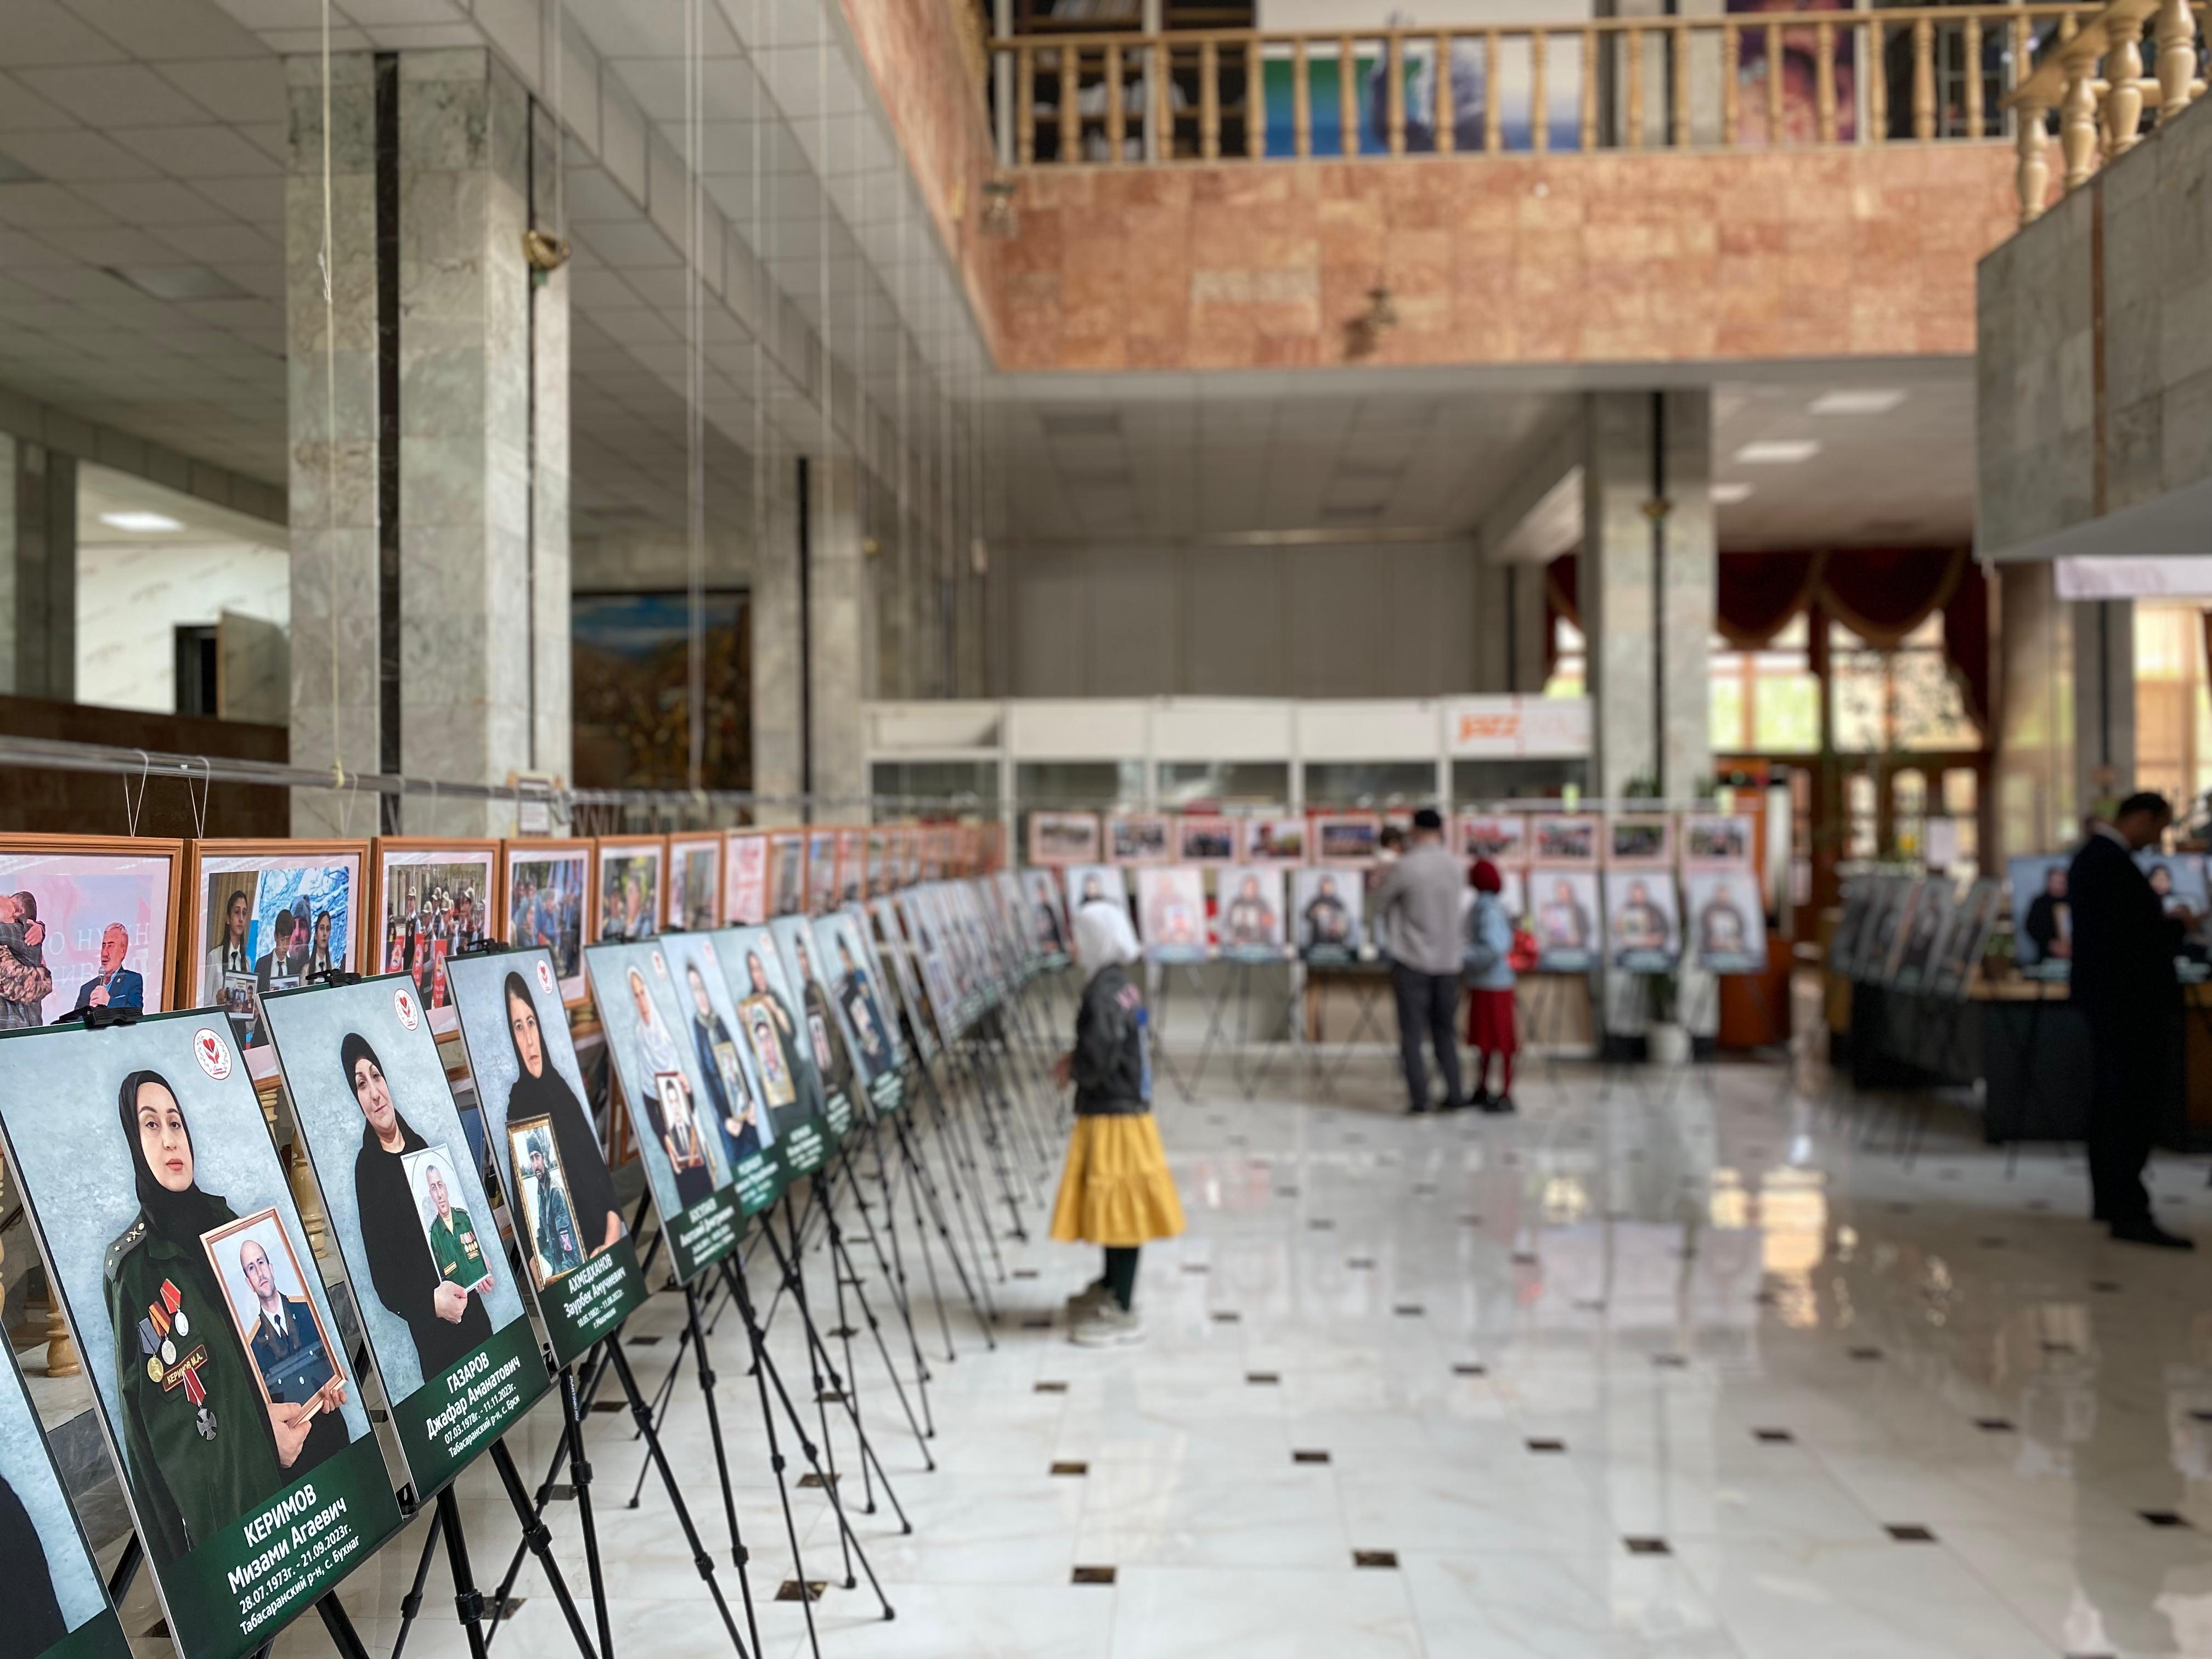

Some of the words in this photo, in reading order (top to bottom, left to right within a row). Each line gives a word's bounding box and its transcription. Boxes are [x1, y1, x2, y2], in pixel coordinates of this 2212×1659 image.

[563, 1290, 593, 1318] Заурбек
[591, 1266, 627, 1299] Амучиевич
[568, 1253, 613, 1294] АХМЕДХАНОВ
[426, 1397, 467, 1441] Джафар
[467, 1356, 521, 1406] Аманатович
[446, 1352, 489, 1394] ГАЗАРОВ
[444, 1412, 481, 1444] 07.03.1978г.
[483, 1383, 516, 1413] 11.11.2023г.
[448, 1417, 491, 1458] Табасаранский
[506, 1395, 520, 1410] Ерси
[227, 1539, 290, 1594] Мизами
[291, 1497, 347, 1550] Агаевич
[243, 1483, 317, 1548] КЕРИМОВ
[239, 1567, 296, 1615] 28.07.1973г.
[301, 1524, 352, 1567] 21.09.2023г.
[239, 1575, 307, 1635] Табасаранский
[307, 1566, 325, 1587] р-н,
[324, 1559, 333, 1570] с.
[332, 1536, 359, 1563] Бухнаг
